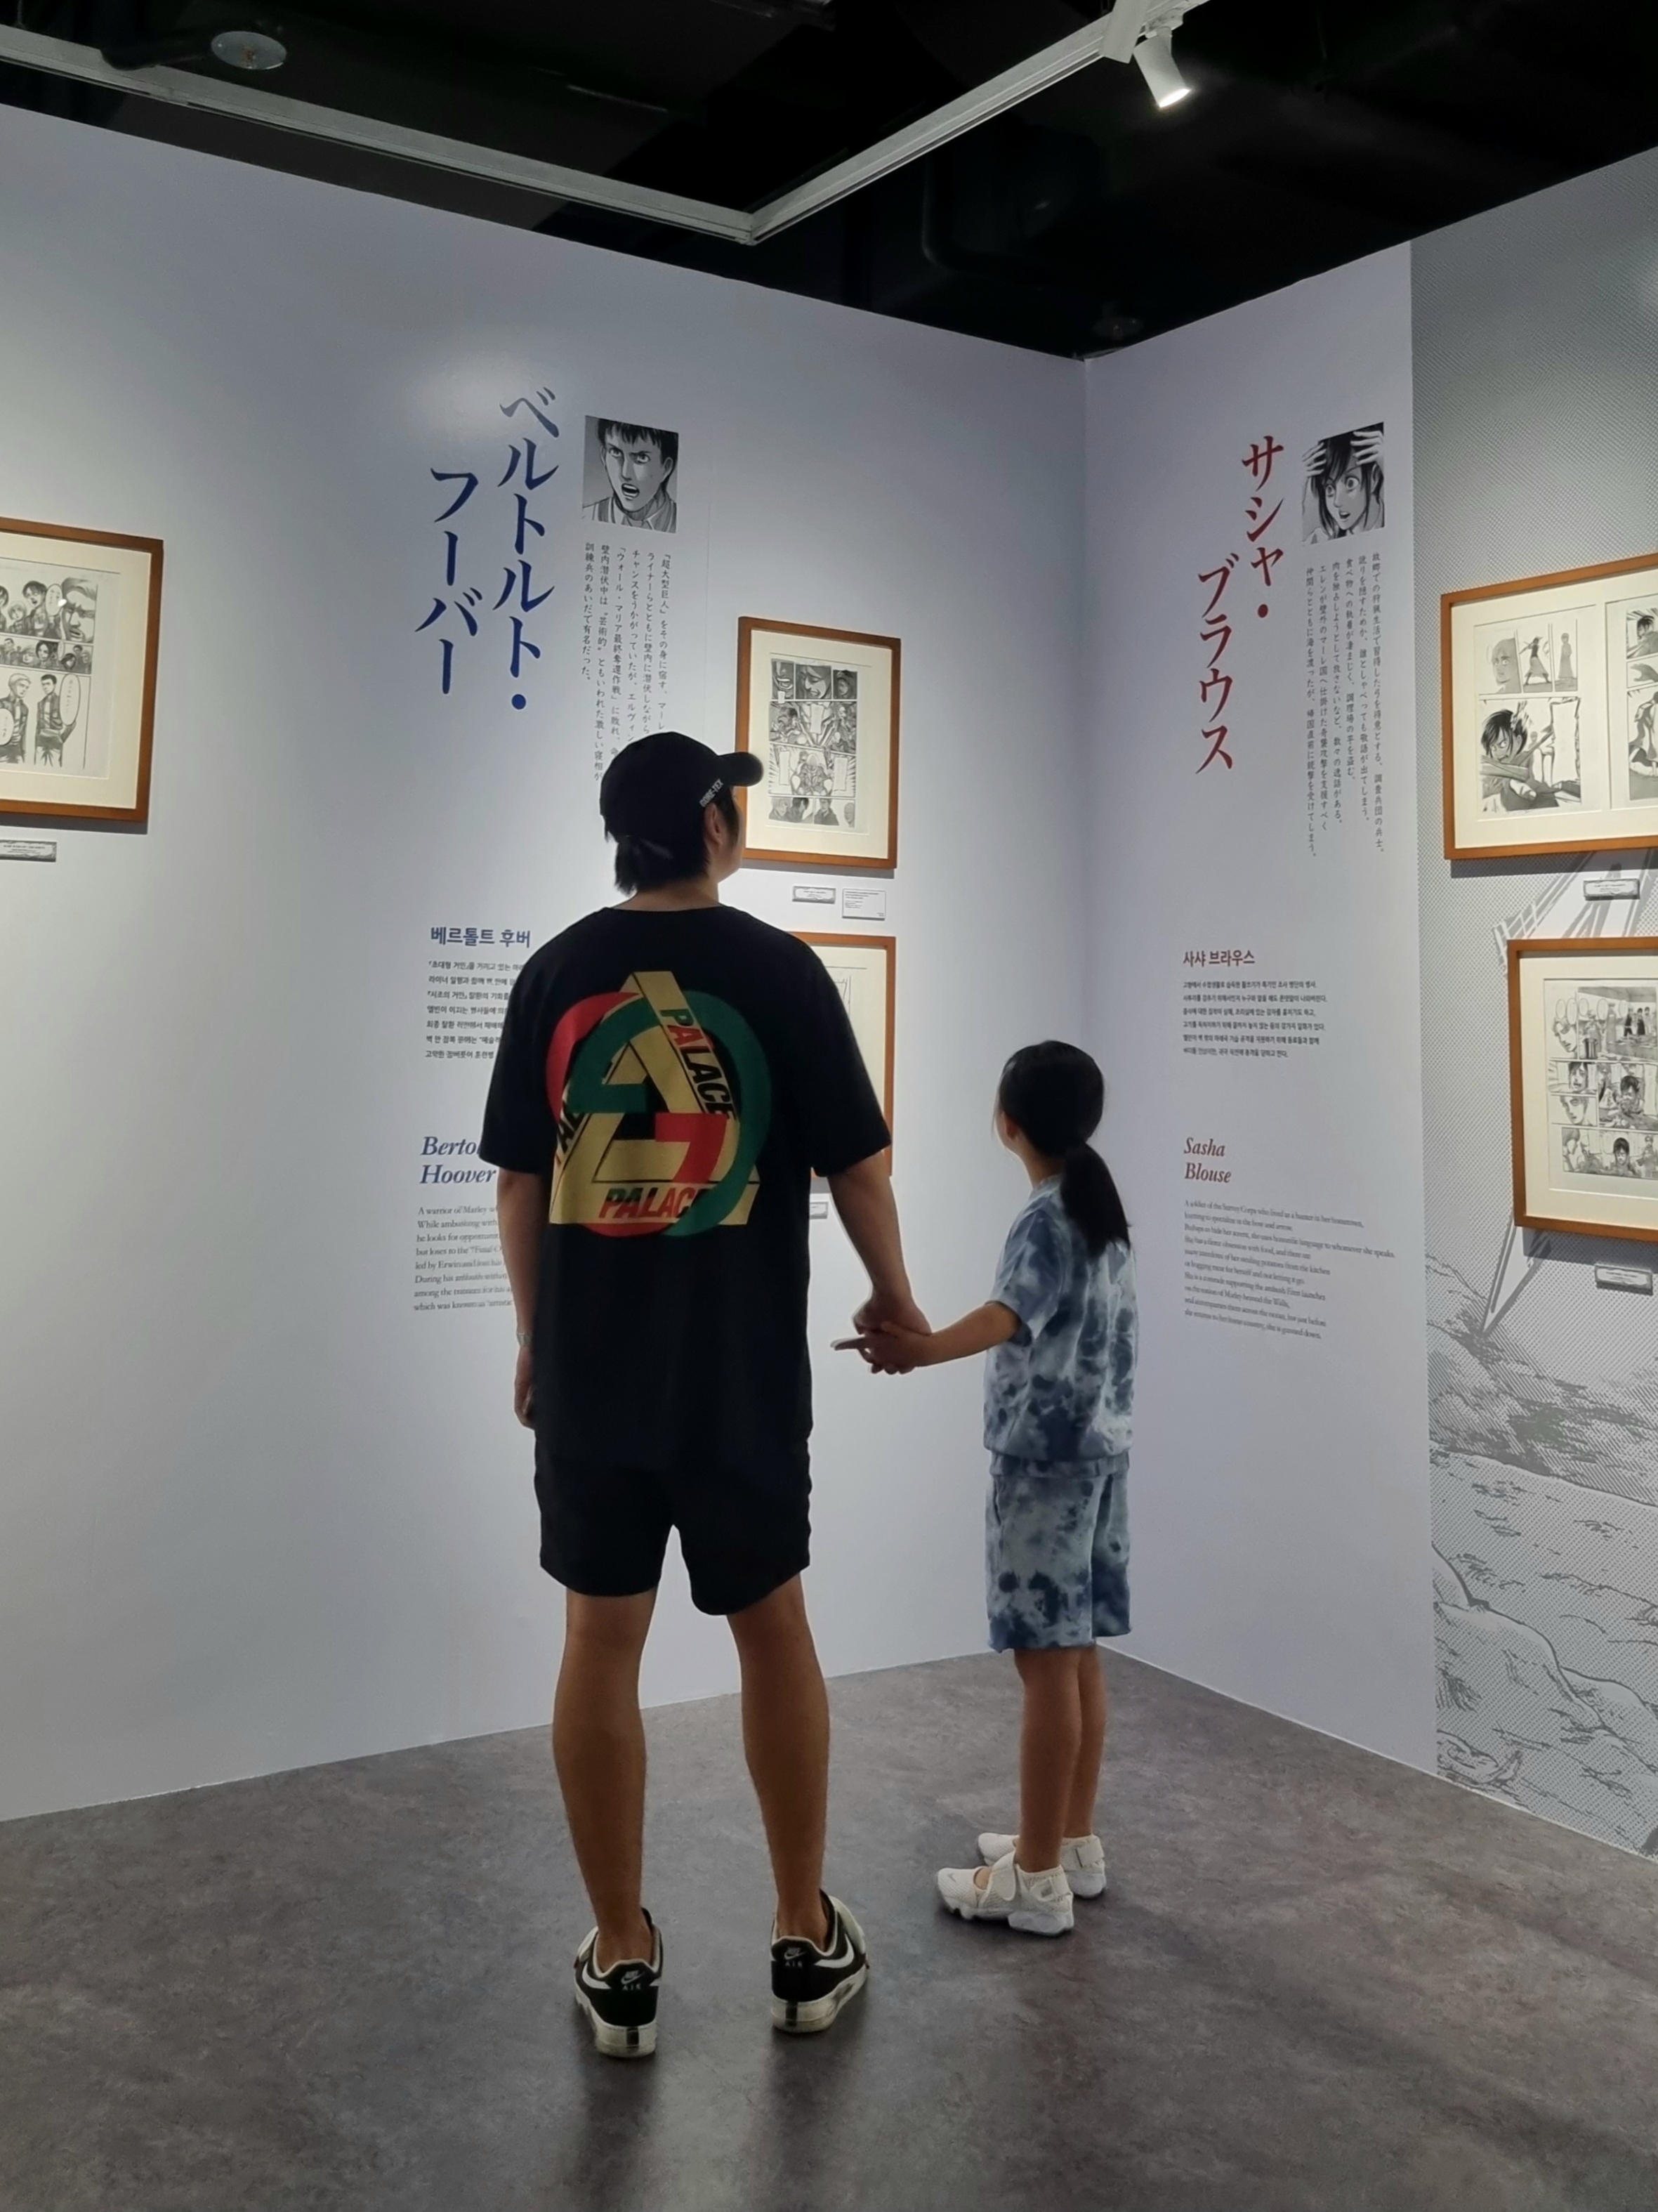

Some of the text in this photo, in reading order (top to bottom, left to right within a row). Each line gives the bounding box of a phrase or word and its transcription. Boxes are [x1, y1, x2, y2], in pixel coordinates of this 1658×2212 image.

[1242, 436, 1284, 619] サシャ・
[492, 386, 560, 710] ベルトルト・
[414, 468, 482, 694] フーバー
[1196, 552, 1239, 775] ブラウス
[699, 778, 724, 807] GORE-TEX
[430, 927, 531, 948] 베르톨트 후버
[1183, 950, 1255, 967] 사샤 브라우스
[428, 976, 448, 984] 라이너
[1184, 1137, 1225, 1157] Sasha
[420, 1164, 496, 1184] Hoover
[1184, 1162, 1231, 1183] Blouse
[599, 1187, 709, 1218] PALAC
[418, 1220, 439, 1229] While
[428, 1233, 446, 1242] looks
[428, 1261, 436, 1271] by
[415, 1274, 442, 1285] During
[414, 1302, 436, 1311] which
